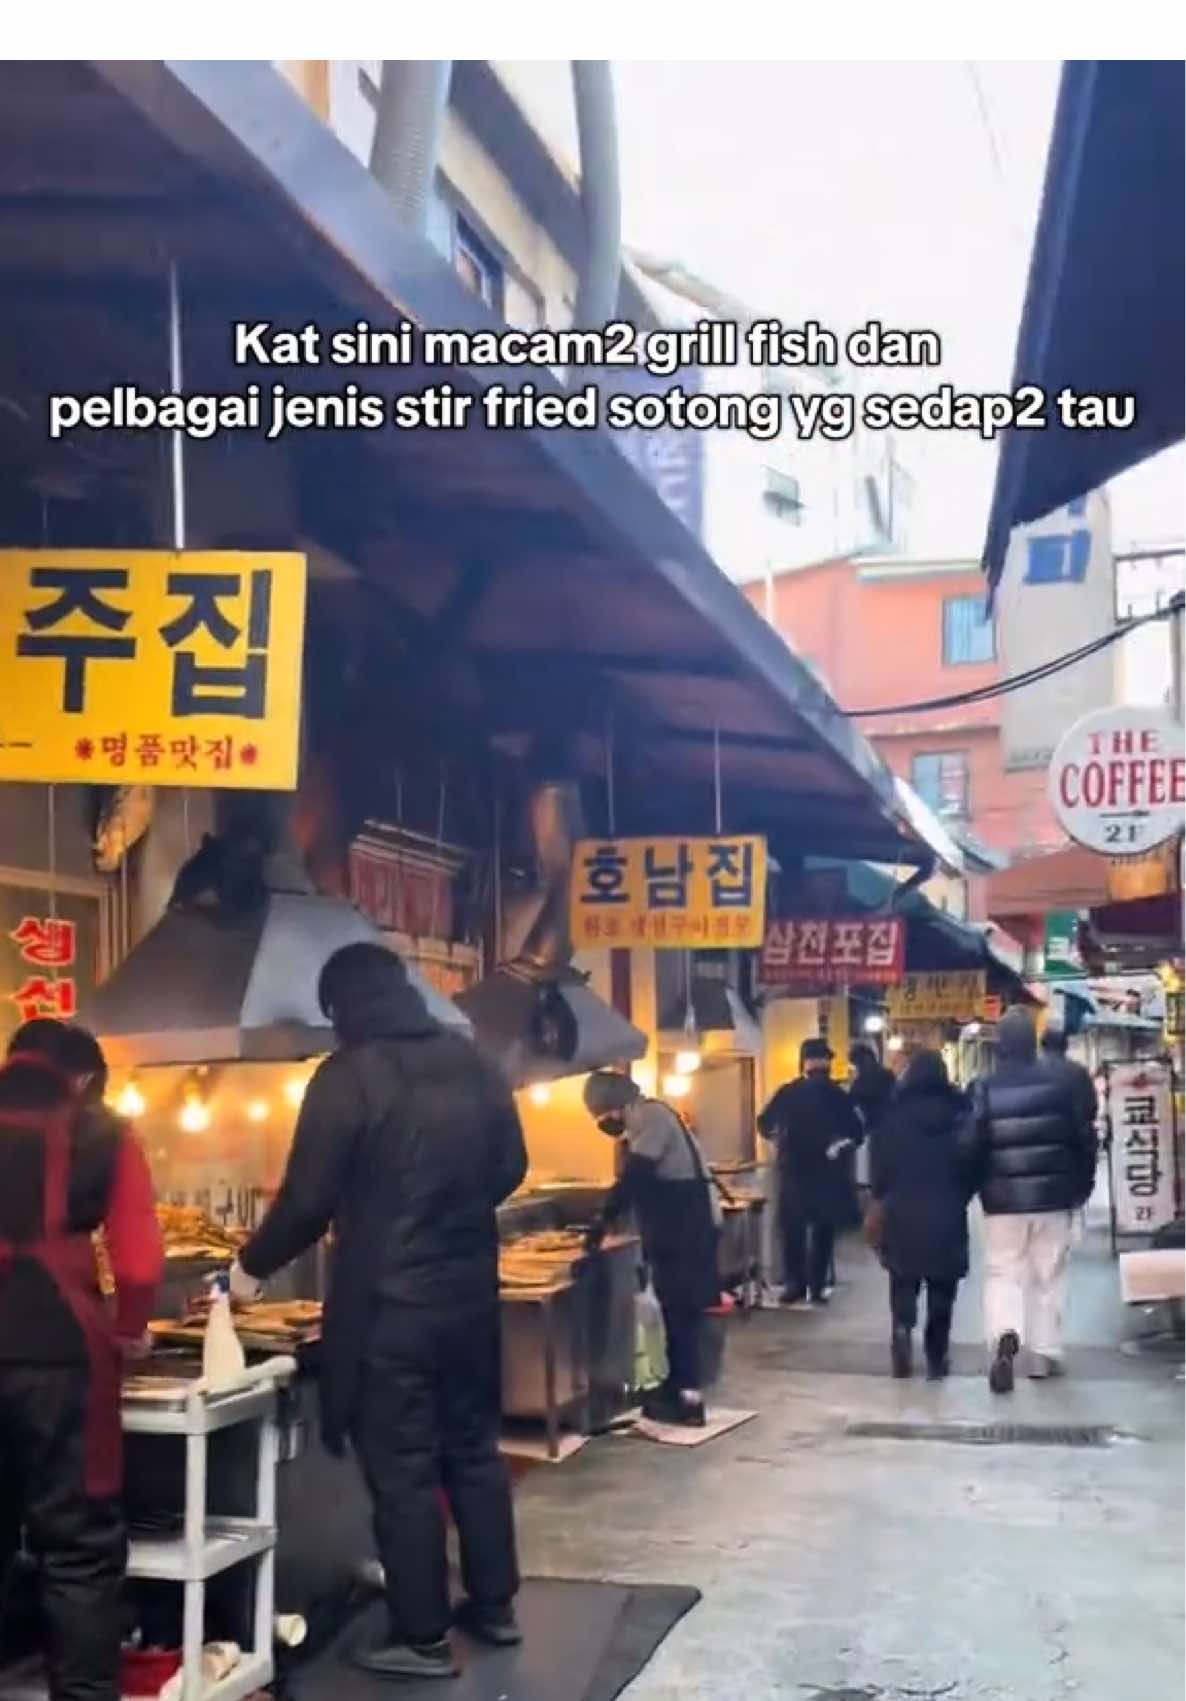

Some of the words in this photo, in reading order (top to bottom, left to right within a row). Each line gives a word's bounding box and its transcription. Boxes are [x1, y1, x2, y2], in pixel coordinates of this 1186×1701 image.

[15, 567, 273, 719] 주집
[100, 732, 234, 770] 명품맛집
[1087, 729, 1160, 755] THE
[580, 842, 753, 908] 호남집
